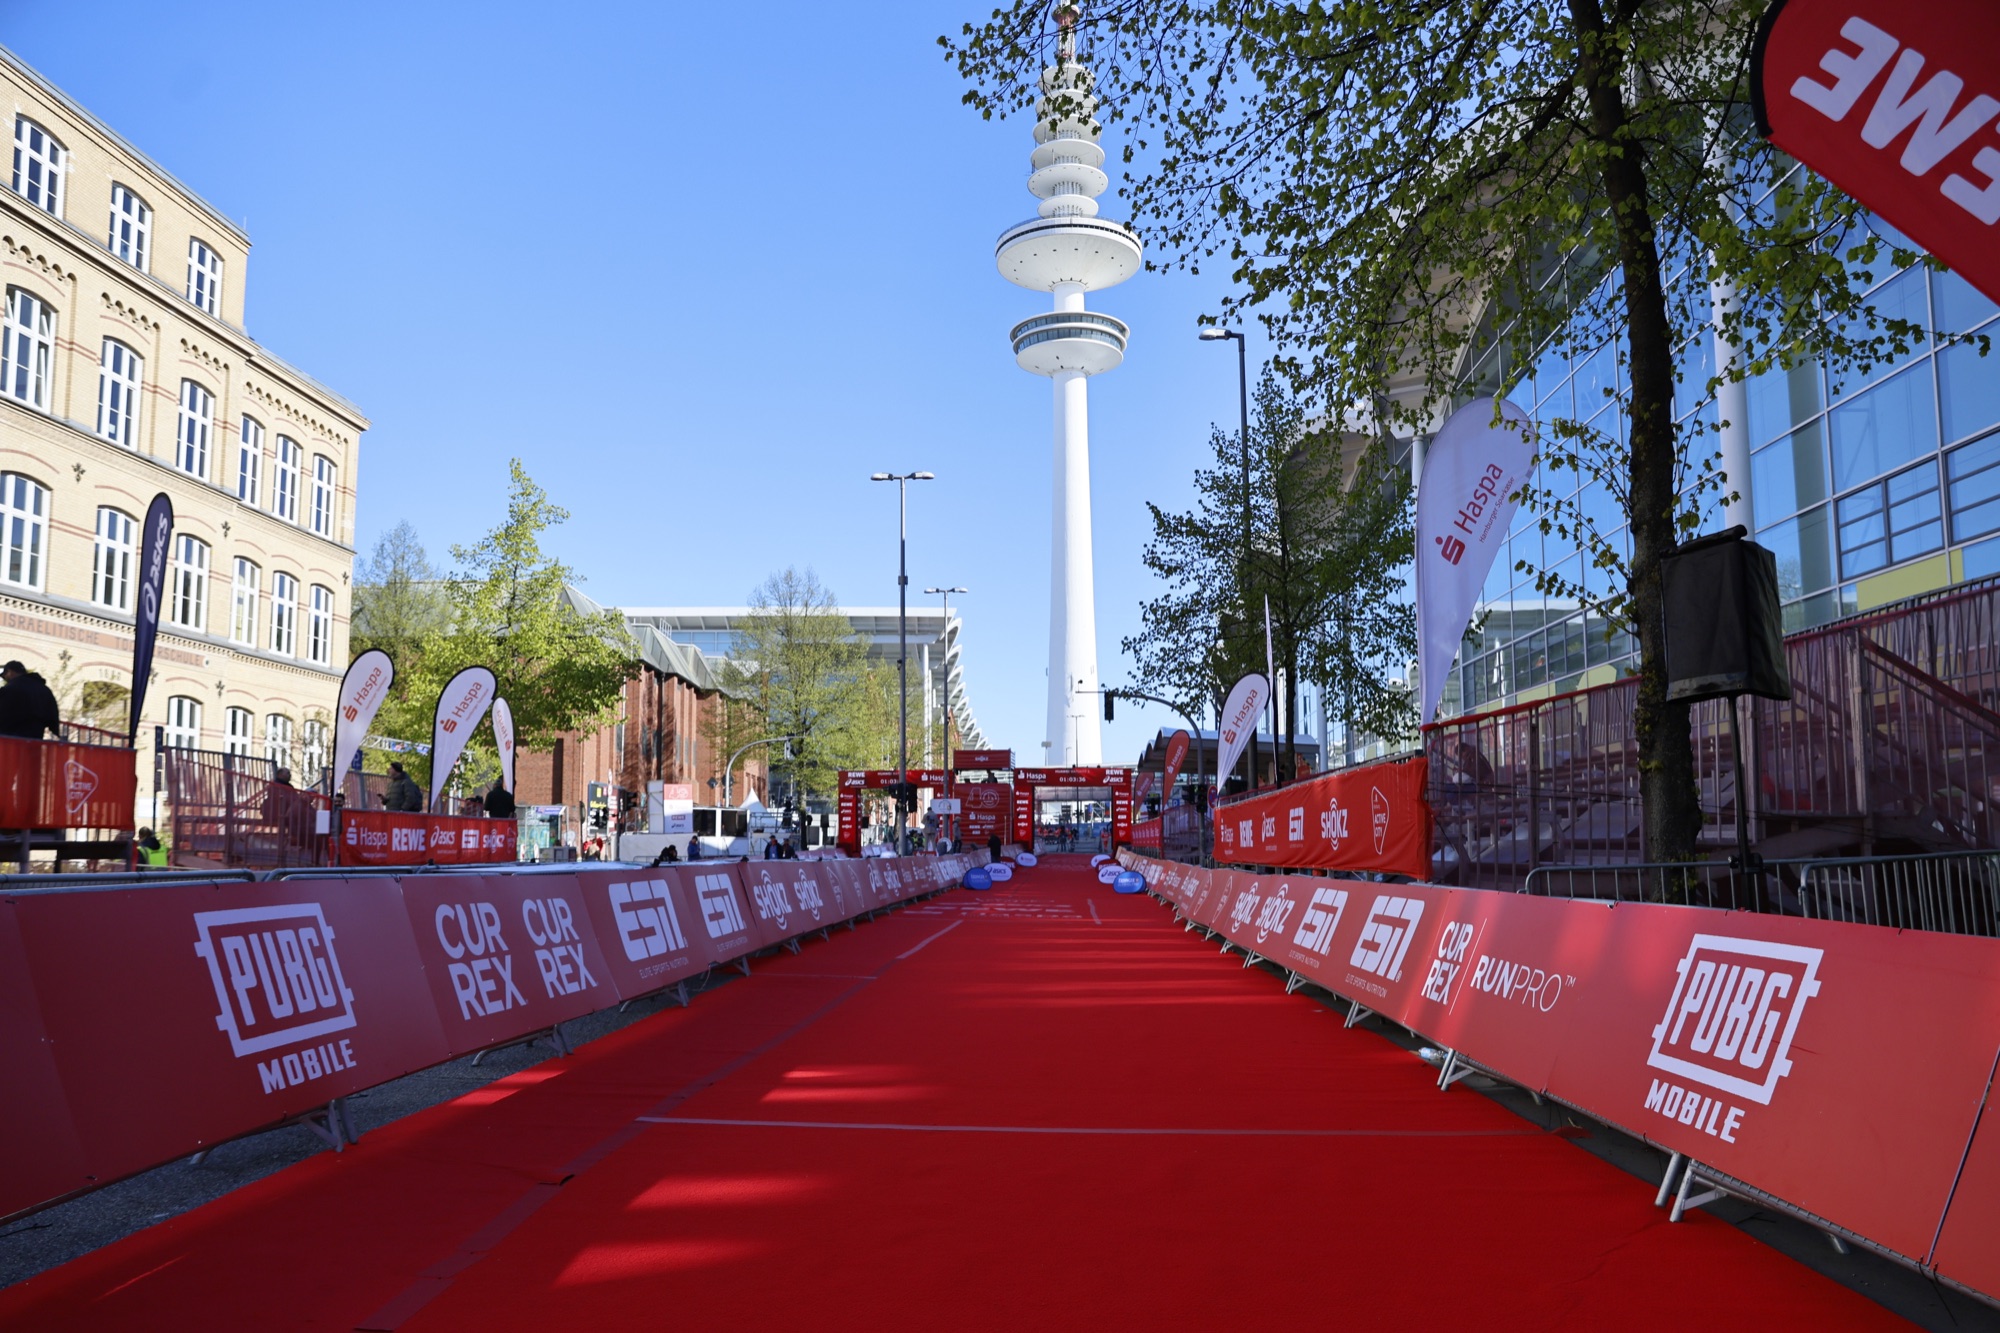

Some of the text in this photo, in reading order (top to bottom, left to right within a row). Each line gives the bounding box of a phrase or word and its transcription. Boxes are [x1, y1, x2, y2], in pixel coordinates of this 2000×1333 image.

[1453, 463, 1503, 534] Haspa
[1478, 507, 1498, 543] Hamburger
[2, 611, 100, 646] ISRAELITISCHE
[353, 666, 382, 706] Haspa
[452, 681, 482, 718] Haspa
[1233, 688, 1257, 729] Haspa
[1171, 745, 1183, 765] Haspa
[1026, 773, 1046, 781] Haspa
[360, 827, 387, 849] Haspa
[392, 827, 426, 851] REWE
[438, 829, 455, 845] asics
[483, 833, 505, 849] SHOKZ
[1224, 823, 1234, 847] Haspa
[1239, 819, 1253, 848] REWE
[1265, 817, 1276, 838] asics
[1321, 808, 1348, 839] SHOKZ
[1374, 813, 1386, 825] ACTIVE
[1374, 827, 1383, 838] CITY
[753, 882, 792, 919] SHOKZ
[793, 880, 823, 911] SHOKZ
[1231, 891, 1261, 925] SHOKZ
[1255, 895, 1296, 934] SHOKZ
[435, 902, 509, 959] CUR
[522, 898, 579, 946] CUR
[1438, 920, 1474, 962] CUR
[221, 926, 338, 1026] PUBG
[448, 954, 528, 1021] REX
[535, 943, 598, 999] REX
[1345, 973, 1388, 998] ELITE SPORTS NUTRITION
[1421, 958, 1460, 1005] REX
[1669, 960, 1793, 1069] PUBG
[257, 1038, 358, 1095] MOBILE
[1644, 1078, 1745, 1144] MOBILE
